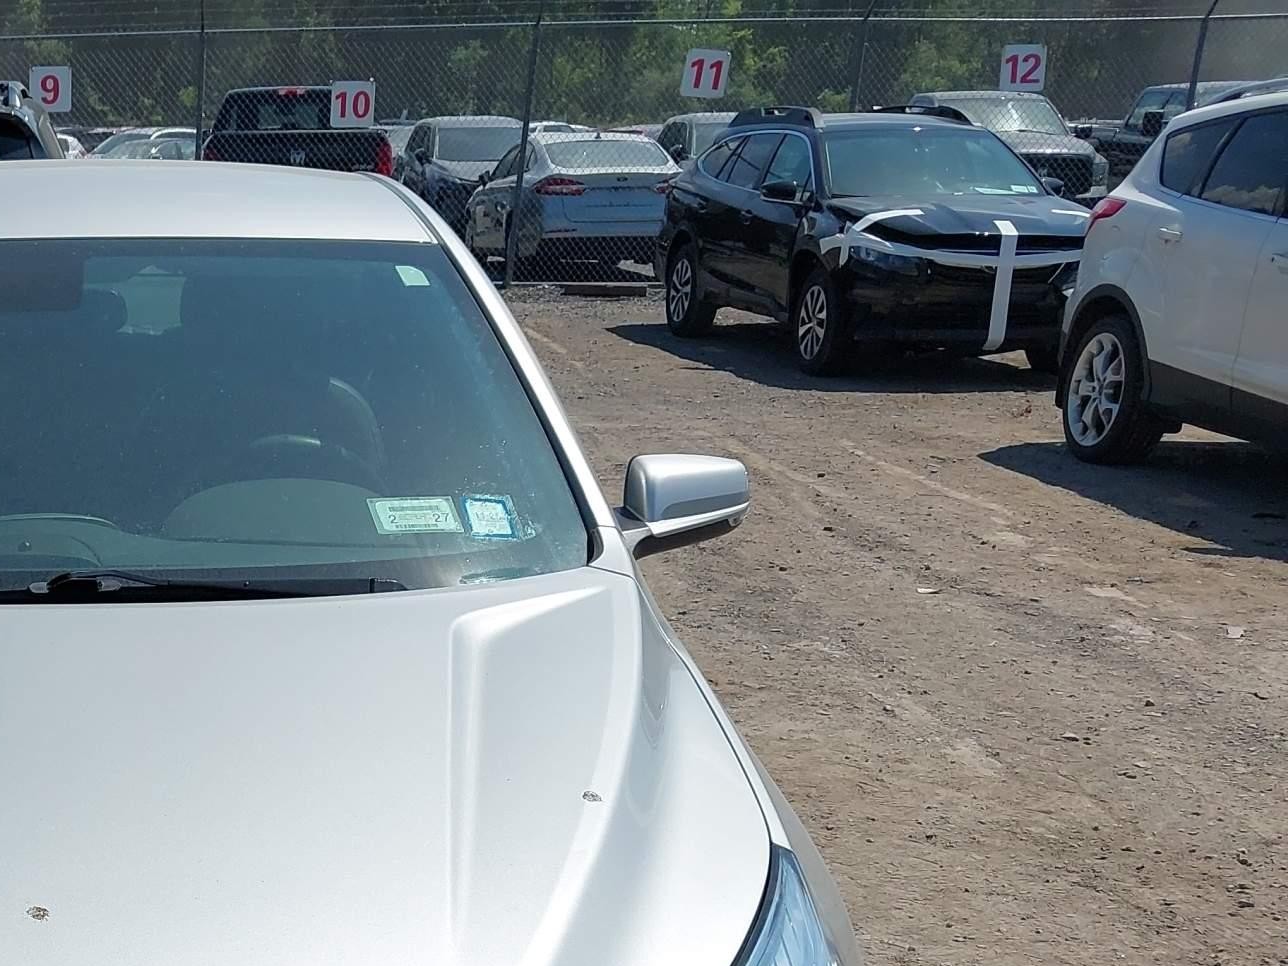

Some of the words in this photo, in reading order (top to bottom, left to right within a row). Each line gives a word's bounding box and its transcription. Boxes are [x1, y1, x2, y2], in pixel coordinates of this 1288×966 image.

[691, 58, 724, 90] 11
[1005, 54, 1041, 84] 12
[40, 75, 60, 105] 9
[335, 90, 371, 119] 10
